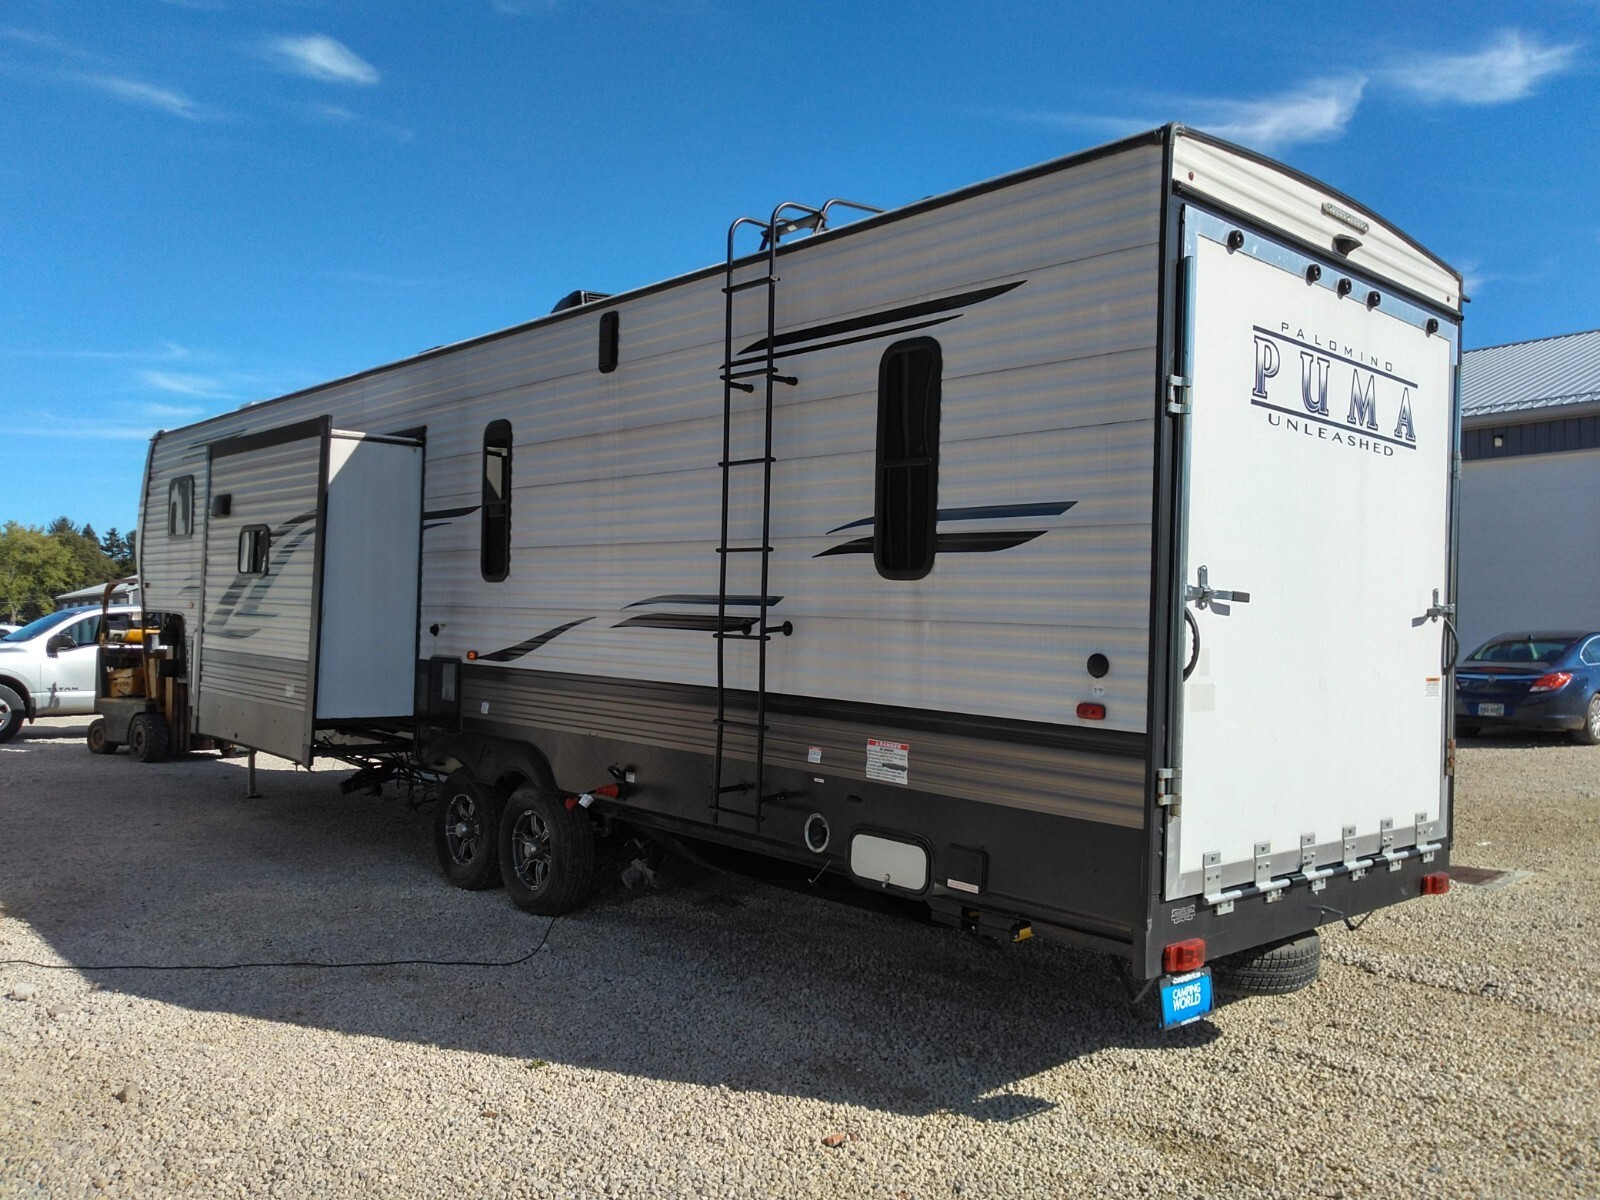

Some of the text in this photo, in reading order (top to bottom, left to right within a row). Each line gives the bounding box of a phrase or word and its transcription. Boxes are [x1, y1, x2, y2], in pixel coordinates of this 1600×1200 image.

[1281, 321, 1393, 372] PALOMINO
[1252, 334, 1416, 442] PUMA
[1268, 413, 1394, 457] UNLEASHED
[1172, 982, 1201, 999] CAMPING
[1173, 993, 1201, 1012] WORLD
